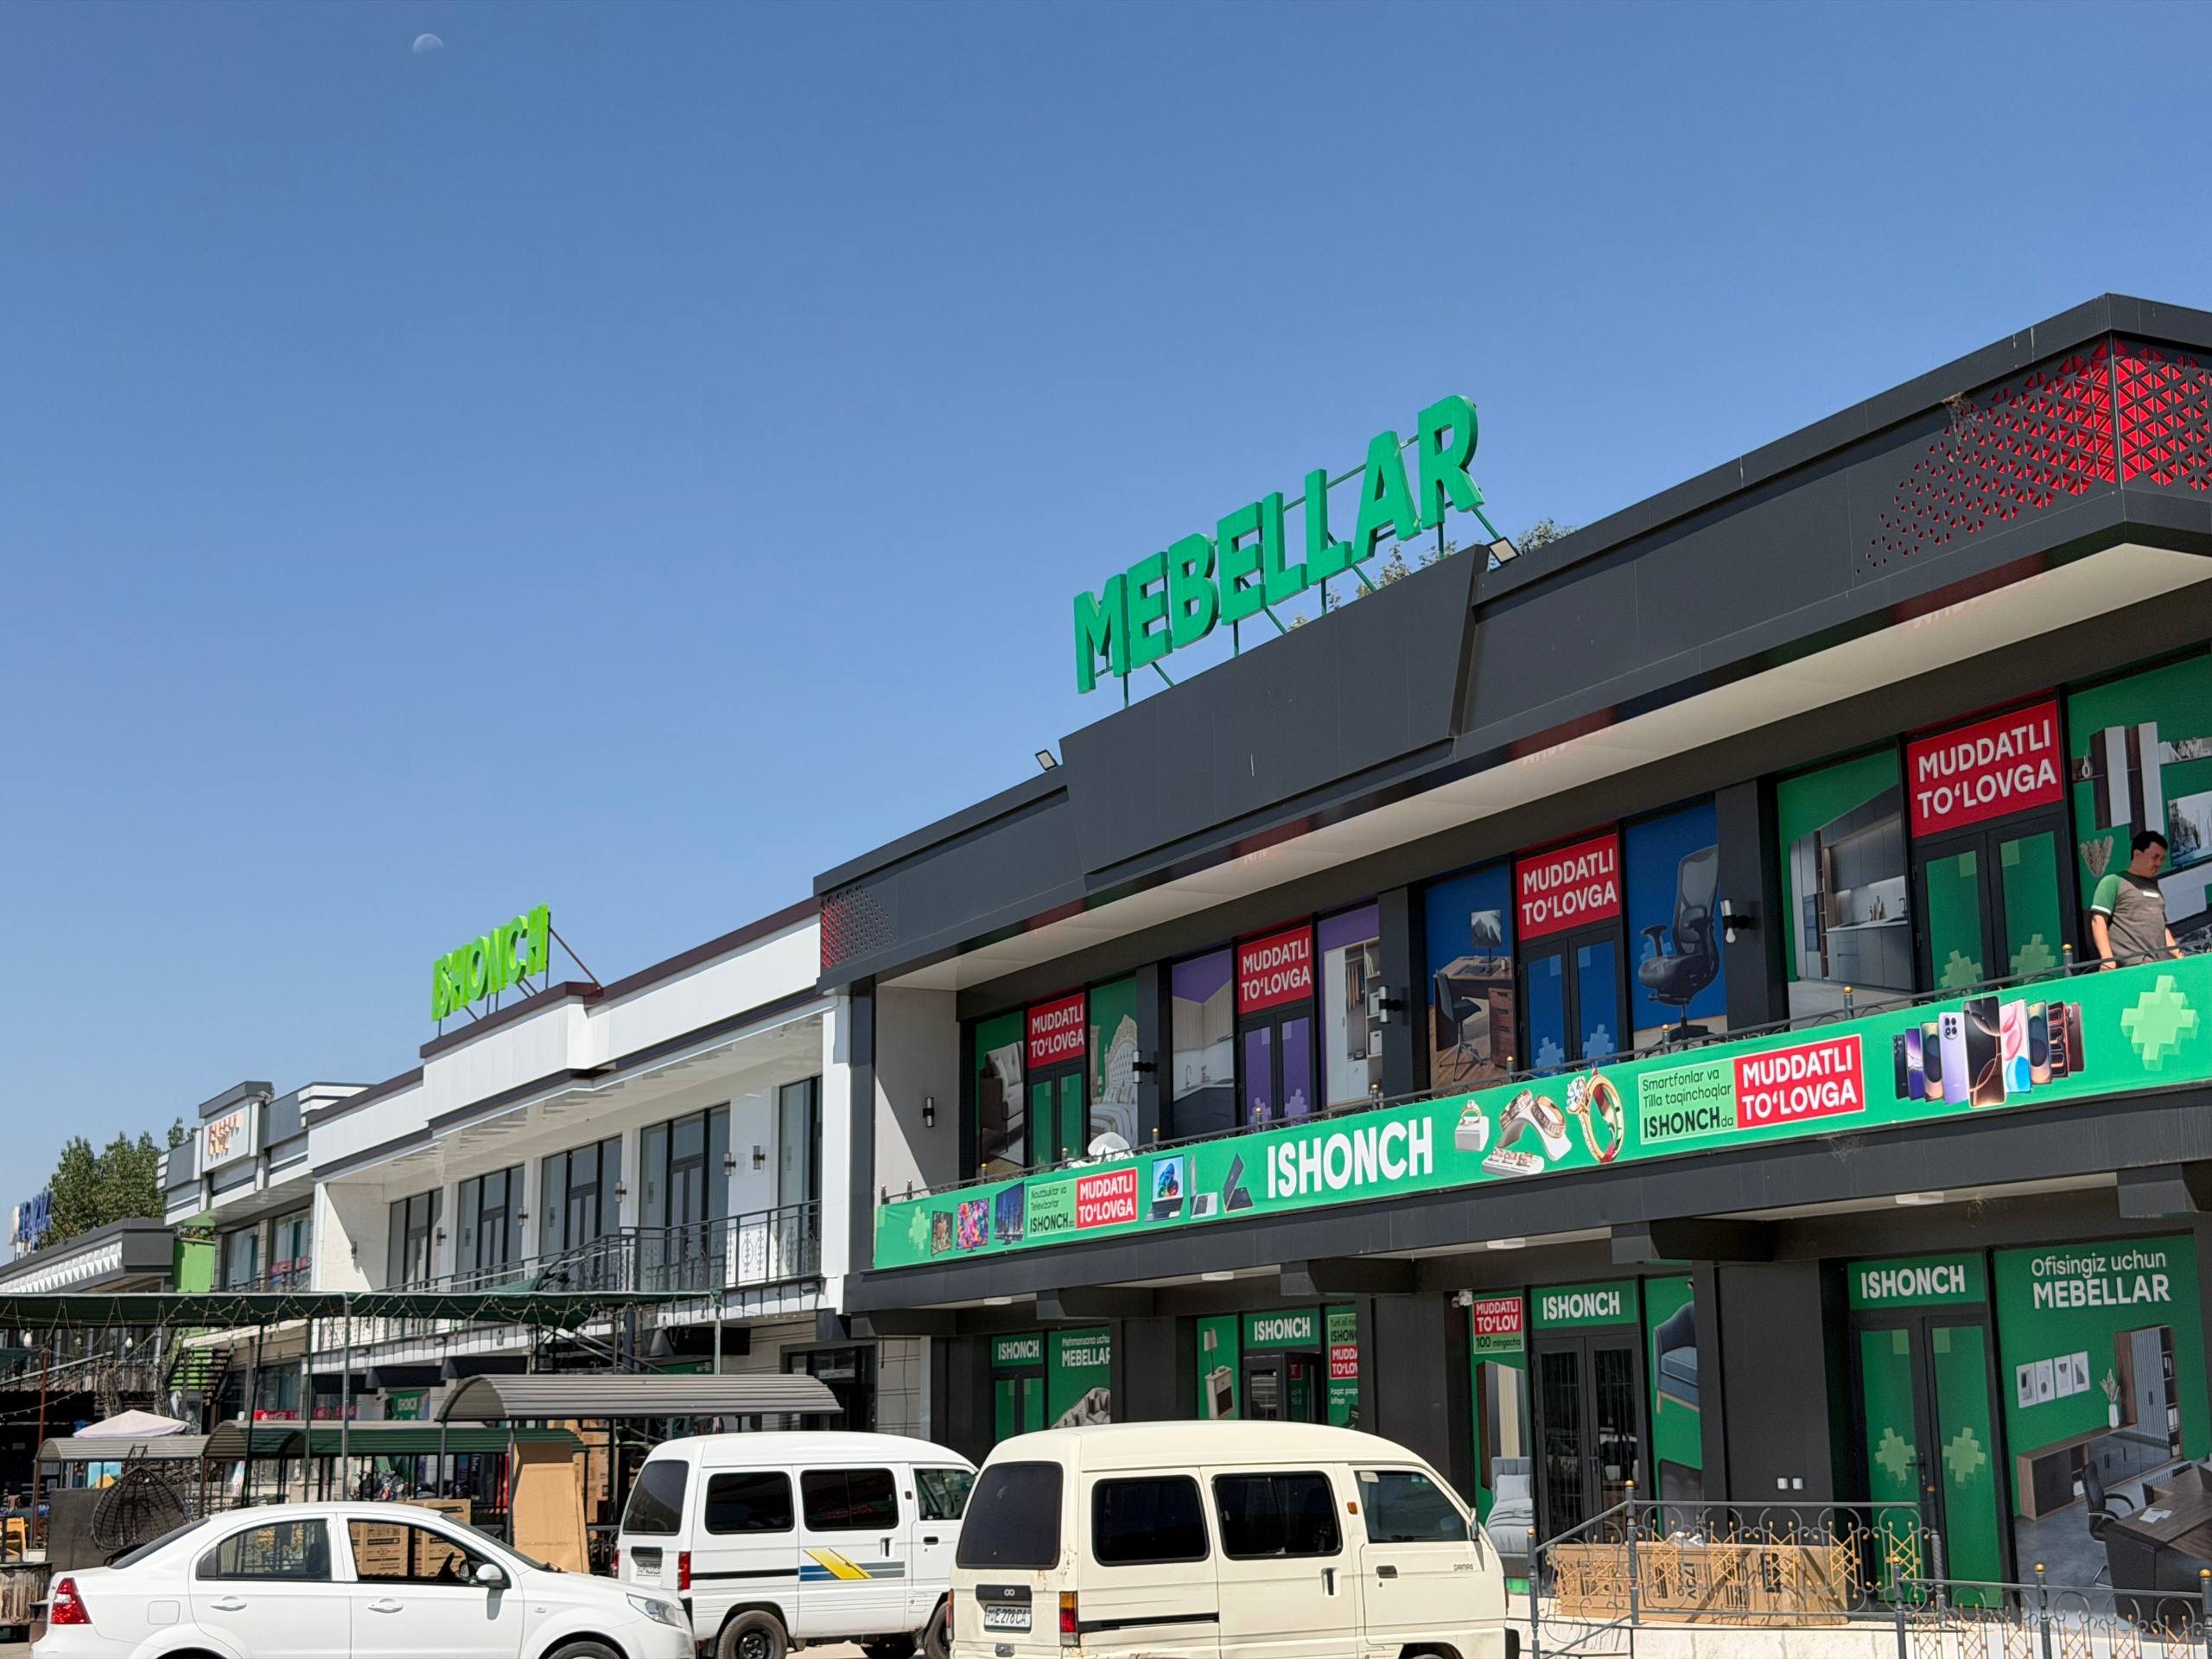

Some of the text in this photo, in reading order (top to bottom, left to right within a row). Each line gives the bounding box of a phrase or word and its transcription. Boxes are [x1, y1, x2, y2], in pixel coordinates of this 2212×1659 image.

[1074, 395, 1484, 694] MEBELLAR
[1918, 719, 2051, 782] MUDDATLI
[1916, 757, 2057, 818] TO‘LOVGA
[1522, 849, 1614, 896] MUDDATLI
[1522, 882, 1618, 925] TO‘LOVGA
[432, 903, 549, 1021] ISHONCH
[1242, 938, 1310, 973] MUDDATLI
[1242, 967, 1311, 1001] TO‘LOVGA
[1032, 1004, 1084, 1032] MUDDATLI
[1031, 1027, 1085, 1054] TO‘LOVGA
[1643, 1068, 1719, 1091] Smartfonlar va
[1743, 1045, 1853, 1089] MUDDATLI
[1643, 1084, 1732, 1109] Tilla taqinchoqlar
[1742, 1078, 1857, 1120] TO‘LOVGA
[1268, 1117, 1433, 1198] ISHONCH
[1079, 1173, 1134, 1201] MUDDATLI
[2031, 1249, 2166, 1279] Ofisingiz uchun
[1861, 1264, 1966, 1299] ISHONCH
[2033, 1274, 2171, 1309] MEBELLAR
[1476, 1300, 1519, 1315] MUDDATLI
[1542, 1291, 1621, 1320] ISHONCH
[1254, 1317, 1311, 1341] ISHONCH
[1477, 1314, 1518, 1332] TO‘LOV
[998, 1340, 1039, 1360] ISHONCH
[1476, 1336, 1491, 1349] 100
